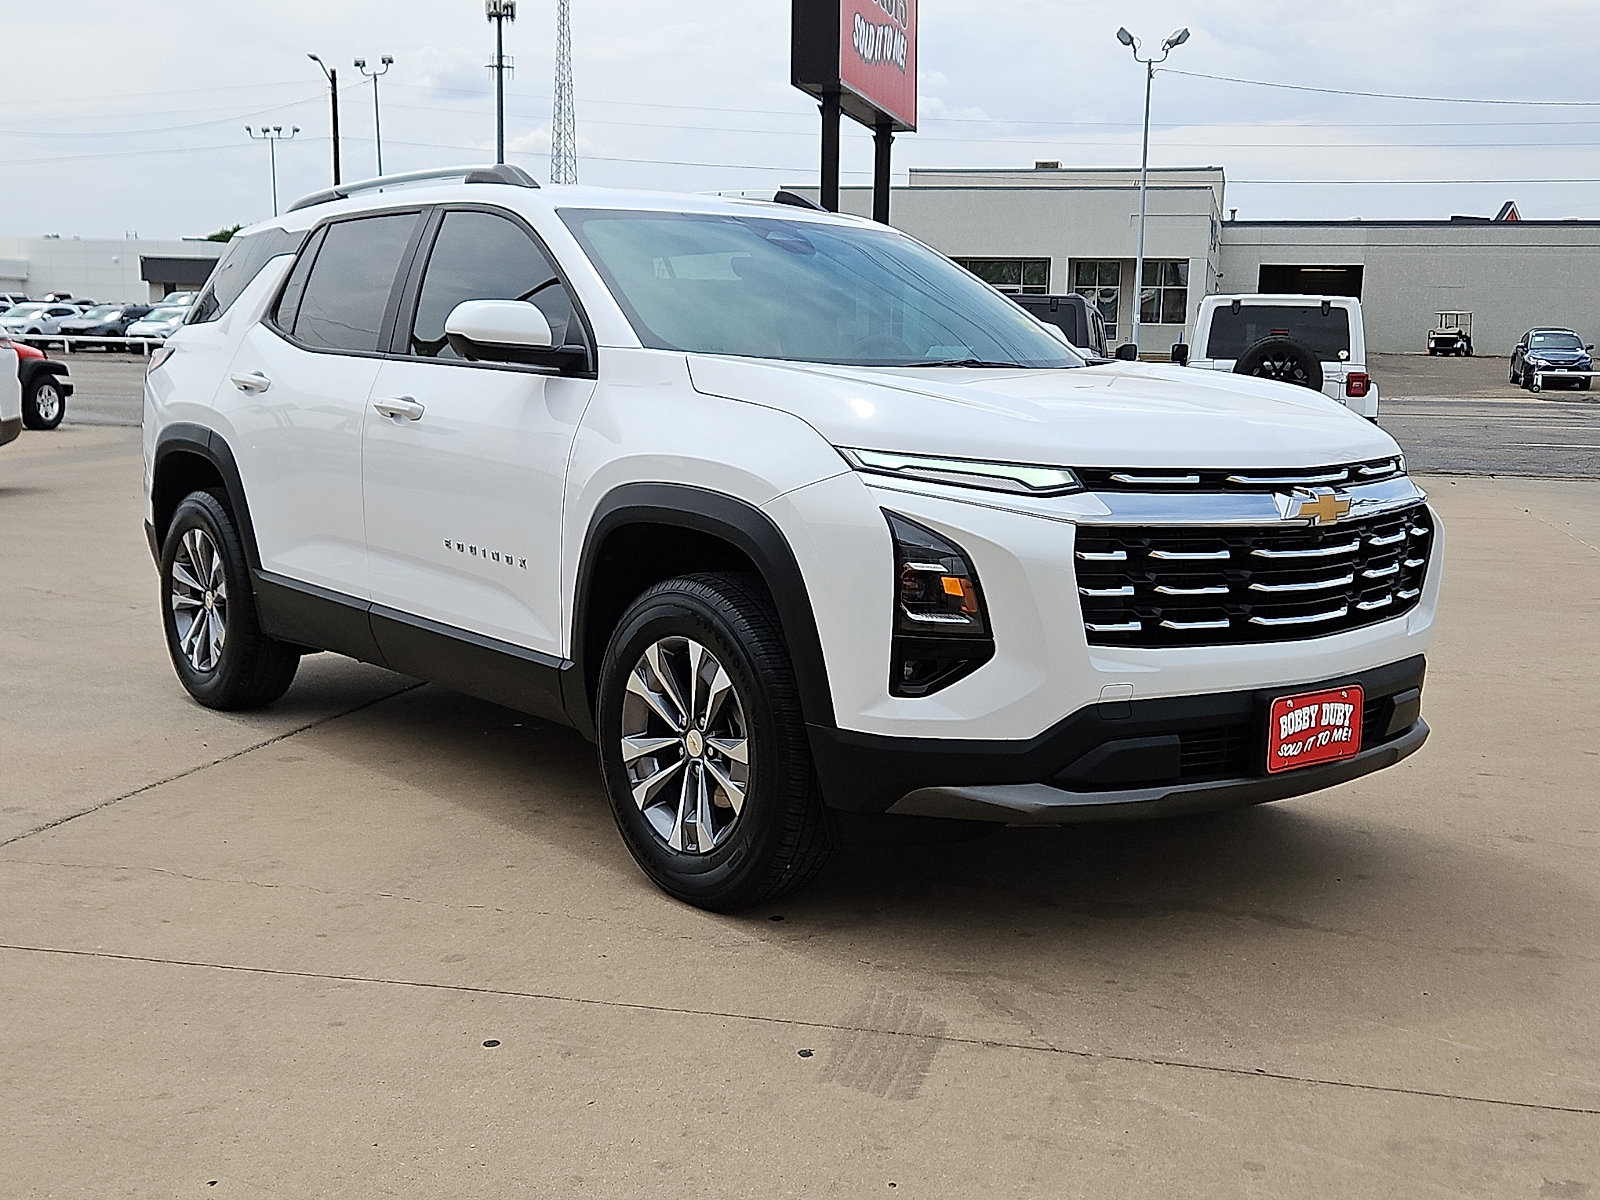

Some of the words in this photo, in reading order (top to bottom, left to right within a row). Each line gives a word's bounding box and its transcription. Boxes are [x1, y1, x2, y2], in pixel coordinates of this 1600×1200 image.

[853, 12, 875, 64] SOLD
[443, 537, 528, 570] EQUINOX
[1279, 704, 1319, 740] BOBBY
[1320, 702, 1354, 727] DUBY
[1277, 741, 1303, 757] SOLD
[1303, 735, 1317, 753] IT
[1316, 730, 1331, 748] TO
[1330, 726, 1353, 742] ME!
